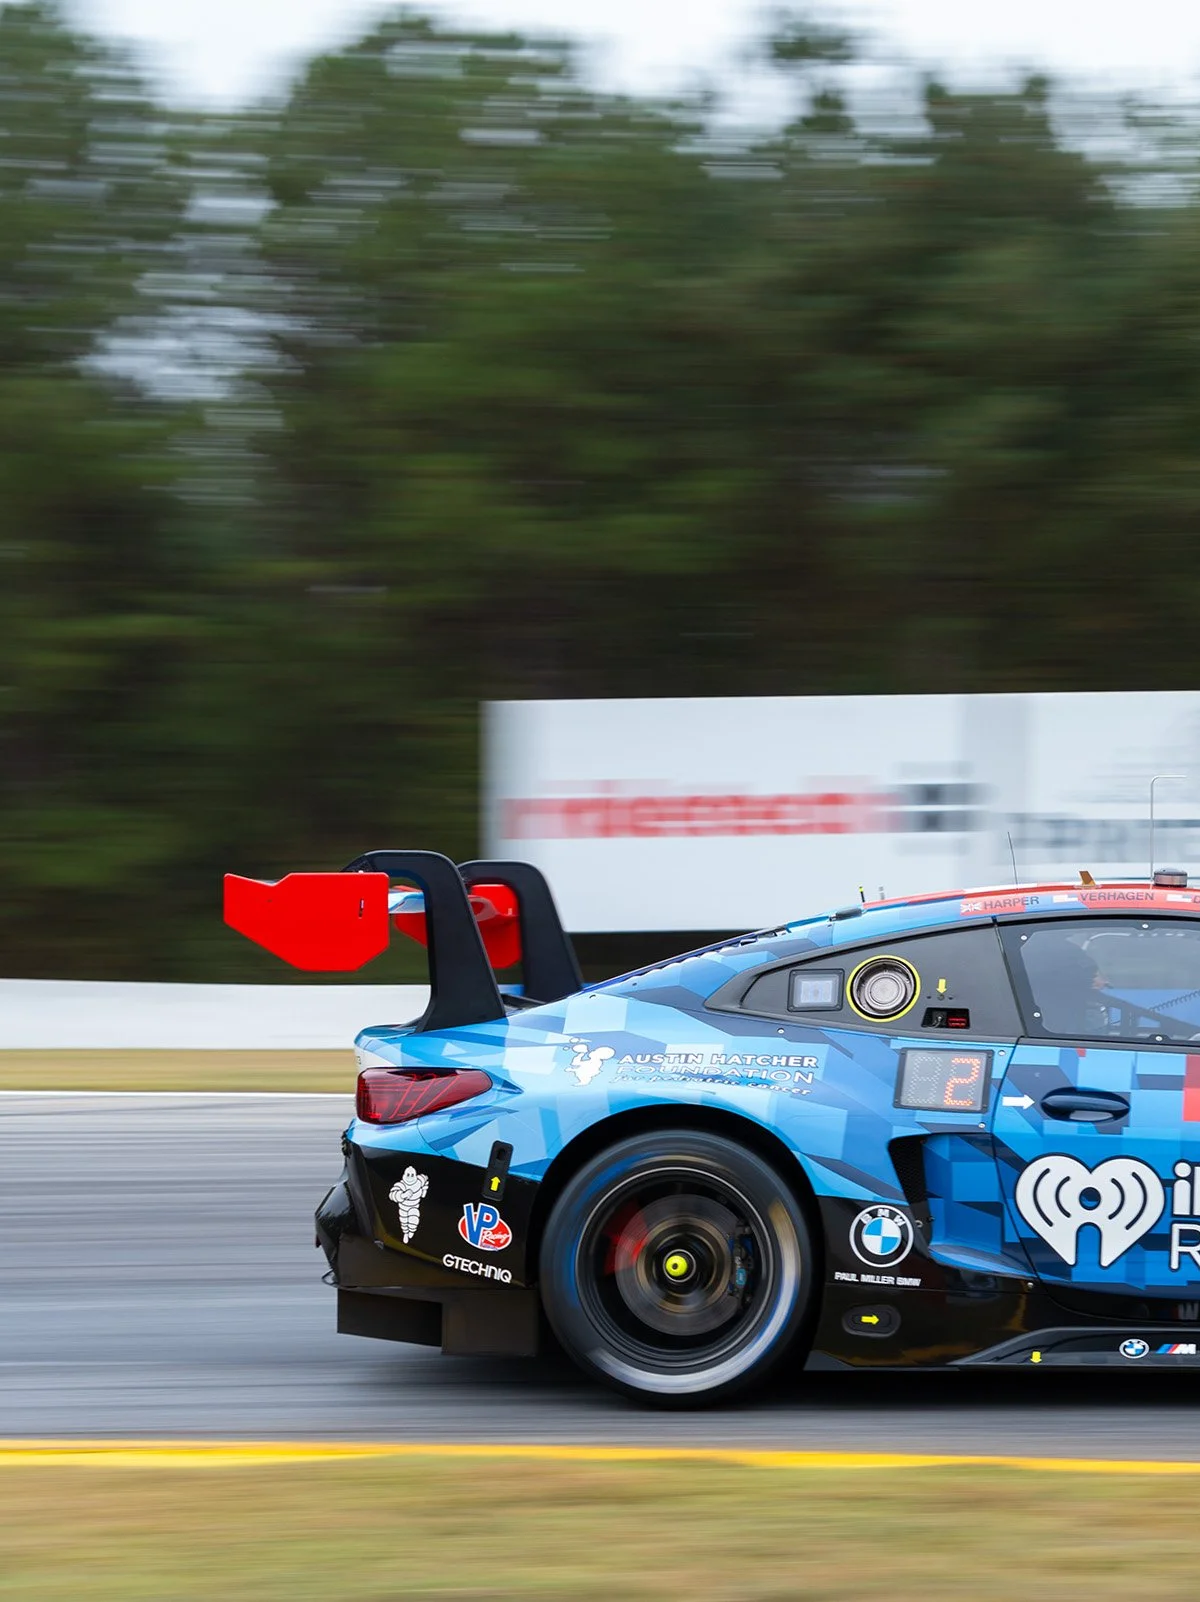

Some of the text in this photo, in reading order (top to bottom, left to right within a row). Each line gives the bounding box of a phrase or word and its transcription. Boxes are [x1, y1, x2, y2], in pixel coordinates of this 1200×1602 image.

[984, 896, 1040, 910] HARPER
[1080, 891, 1155, 902] VERHAGEN
[618, 1053, 819, 1068] AUSTIN HATCHER
[616, 1065, 814, 1084] FOUNDATION
[943, 1057, 981, 1106] 2
[747, 1081, 813, 1096] cancer
[463, 1202, 500, 1248] VP
[860, 1208, 906, 1227] BMW
[442, 1253, 512, 1283] GTECHNIQ
[834, 1271, 922, 1287] PAUL MILLER BMW
